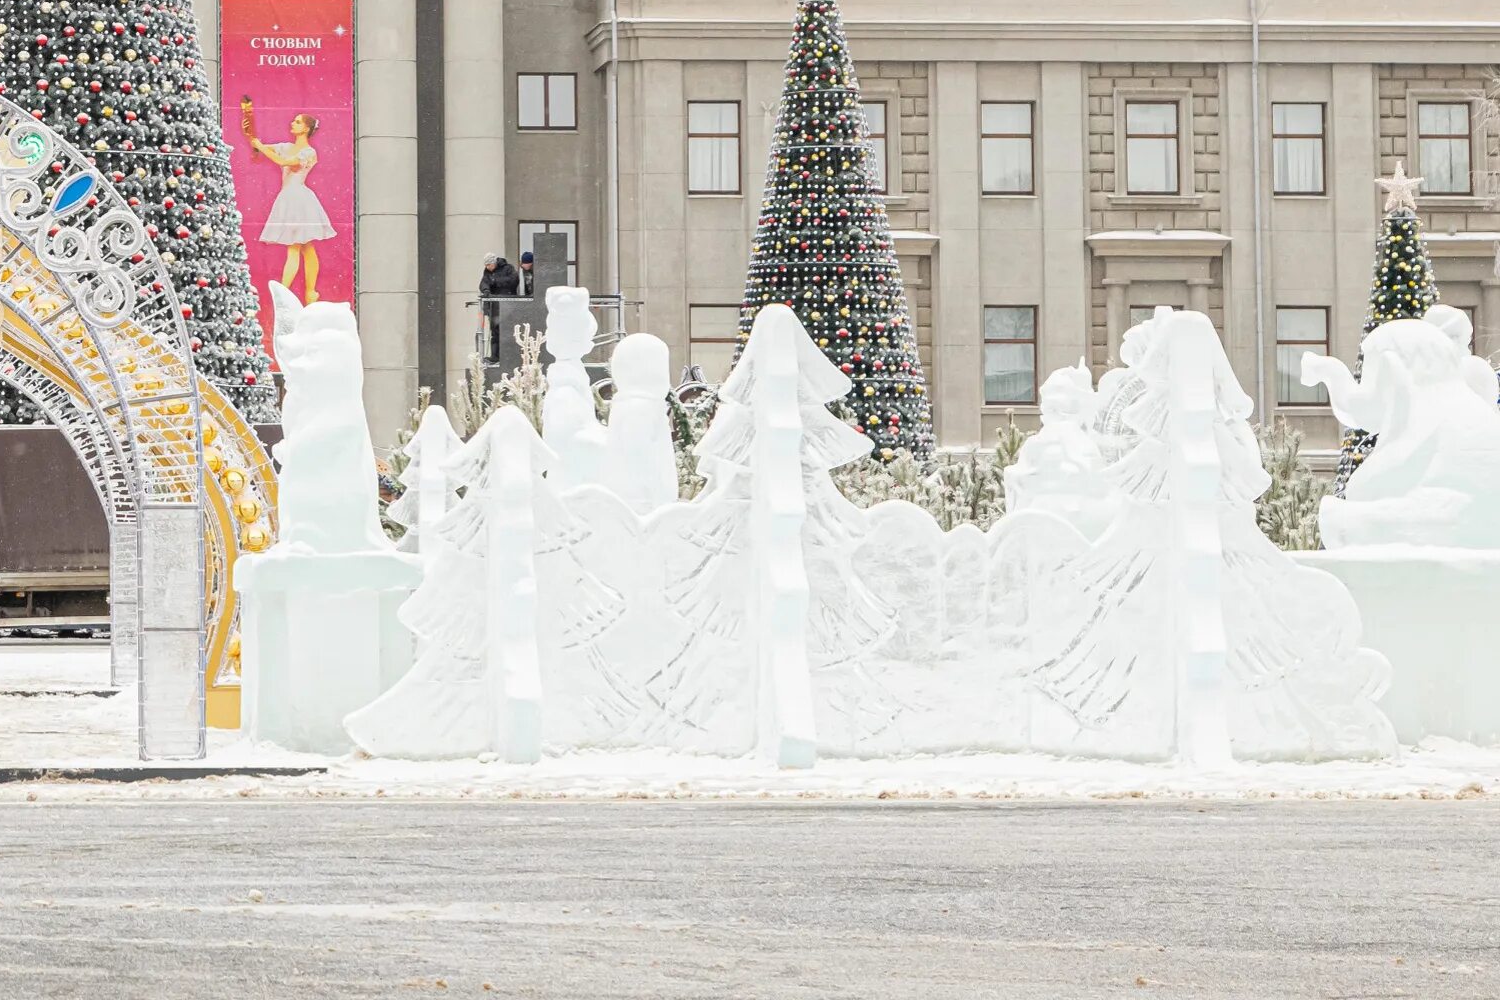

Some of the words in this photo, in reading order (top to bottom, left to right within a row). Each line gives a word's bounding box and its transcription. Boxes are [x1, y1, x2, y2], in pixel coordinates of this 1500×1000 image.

[250, 37, 261, 49] С
[264, 37, 322, 49] НОВЫМ
[258, 54, 316, 67] ГОДОМ!
